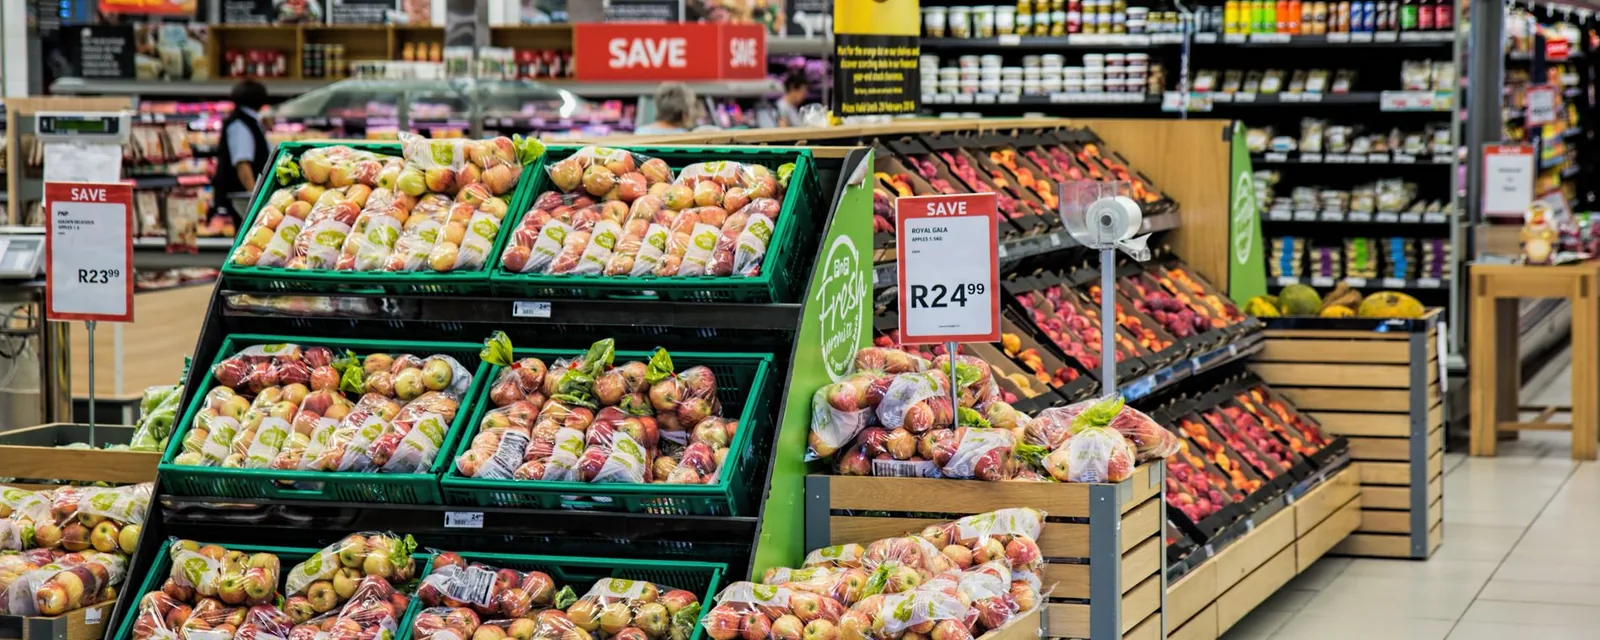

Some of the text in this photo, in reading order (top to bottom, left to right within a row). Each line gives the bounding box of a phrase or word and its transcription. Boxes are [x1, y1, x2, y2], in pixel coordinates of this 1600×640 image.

[608, 37, 687, 68] SAVE
[729, 37, 757, 68] SAVE
[71, 188, 107, 202] SAVE
[926, 201, 967, 216] SAVE
[815, 250, 867, 331] Fresh
